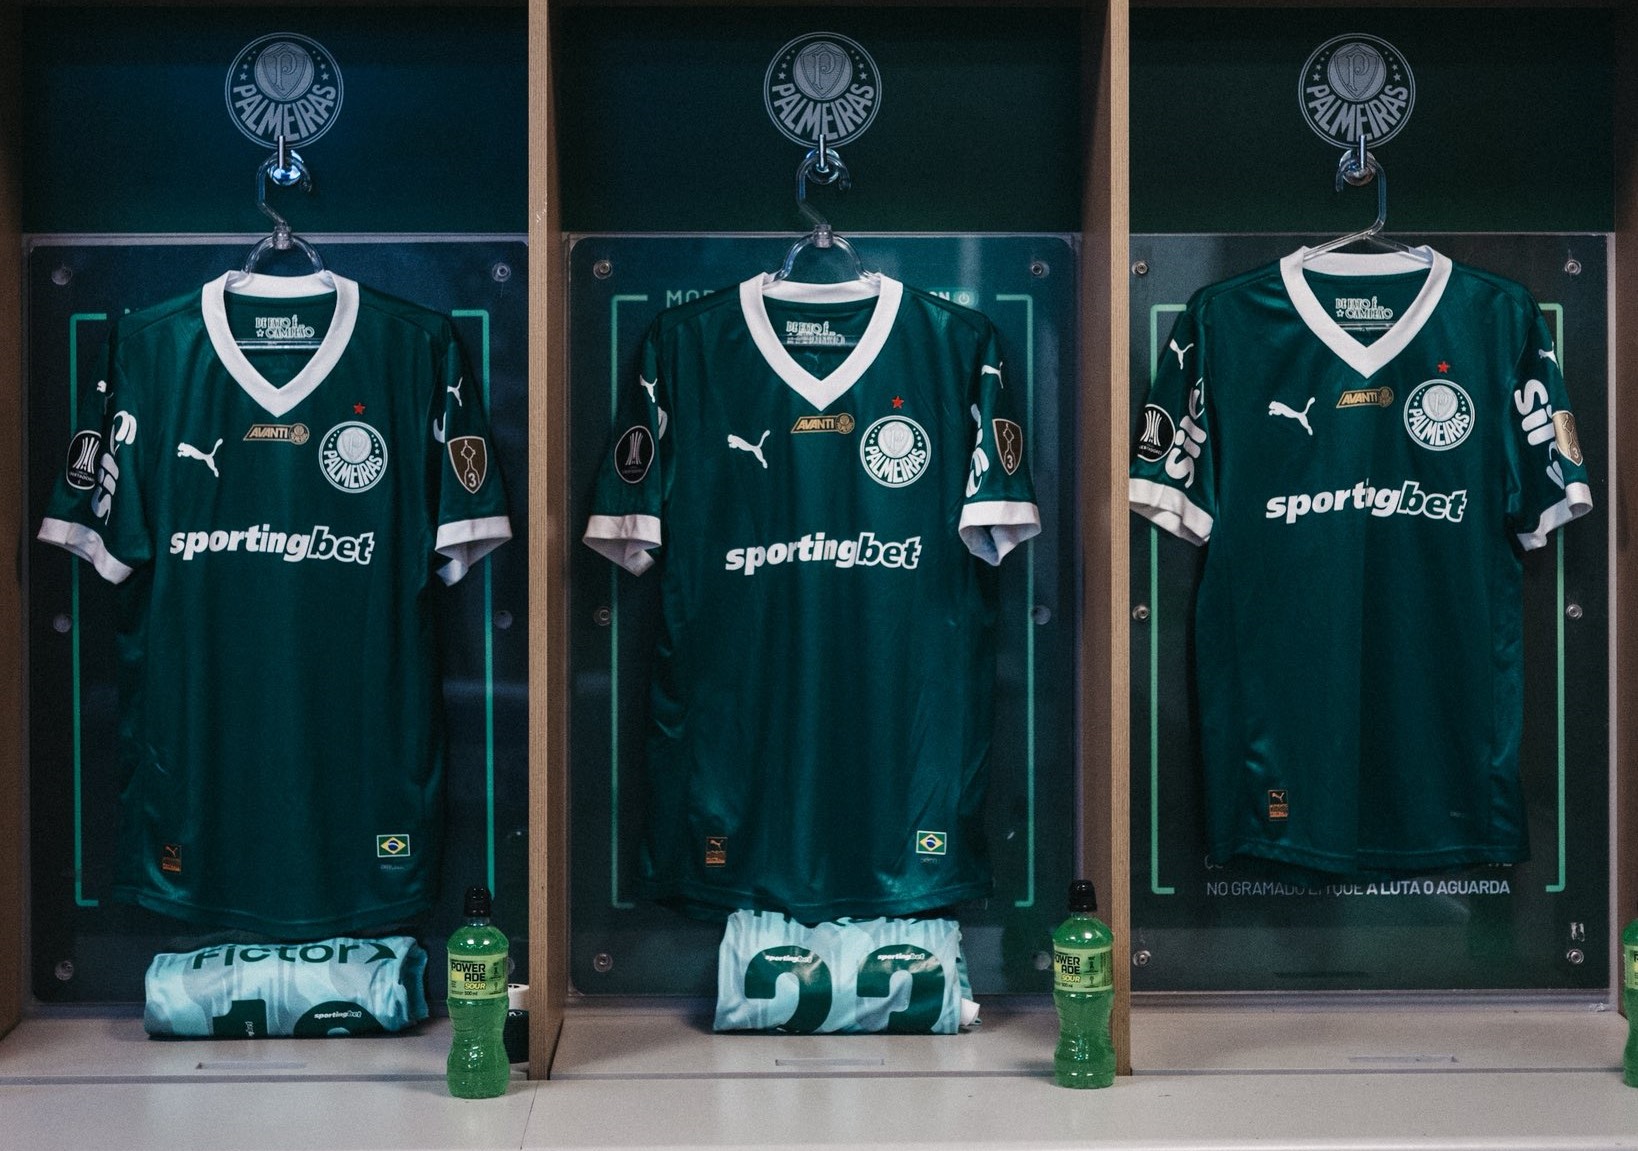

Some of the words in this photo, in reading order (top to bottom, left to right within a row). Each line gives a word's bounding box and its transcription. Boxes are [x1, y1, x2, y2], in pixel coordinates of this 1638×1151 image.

[232, 84, 337, 142] PALMEIRAS
[771, 83, 875, 141] PALMEIRAS
[1306, 84, 1409, 142] PALMEIRAS
[1341, 391, 1378, 405] AVANTI
[796, 418, 835, 430] AVANTI
[1408, 408, 1470, 446] PALMEIRAS
[248, 427, 289, 439] AVANTI
[323, 449, 383, 488] PALMEIRAS
[865, 445, 927, 483] PALMEIRAS
[1006, 454, 1013, 469] 3
[467, 472, 477, 488] 3
[170, 523, 375, 565] sportingbet
[725, 532, 922, 576] sportingbet
[1206, 881, 1229, 896] NO
[1366, 882, 1378, 895] A
[1380, 881, 1421, 895] LUTA
[1423, 880, 1434, 895] O
[1436, 880, 1511, 895] AGUARDA
[193, 943, 361, 969] Fictor
[1055, 954, 1081, 966] OWER
[451, 962, 486, 973] POWER
[1061, 965, 1081, 975] ADE
[464, 972, 486, 982] ADE
[1061, 974, 1081, 983] SOUR
[464, 982, 486, 990] SOUR
